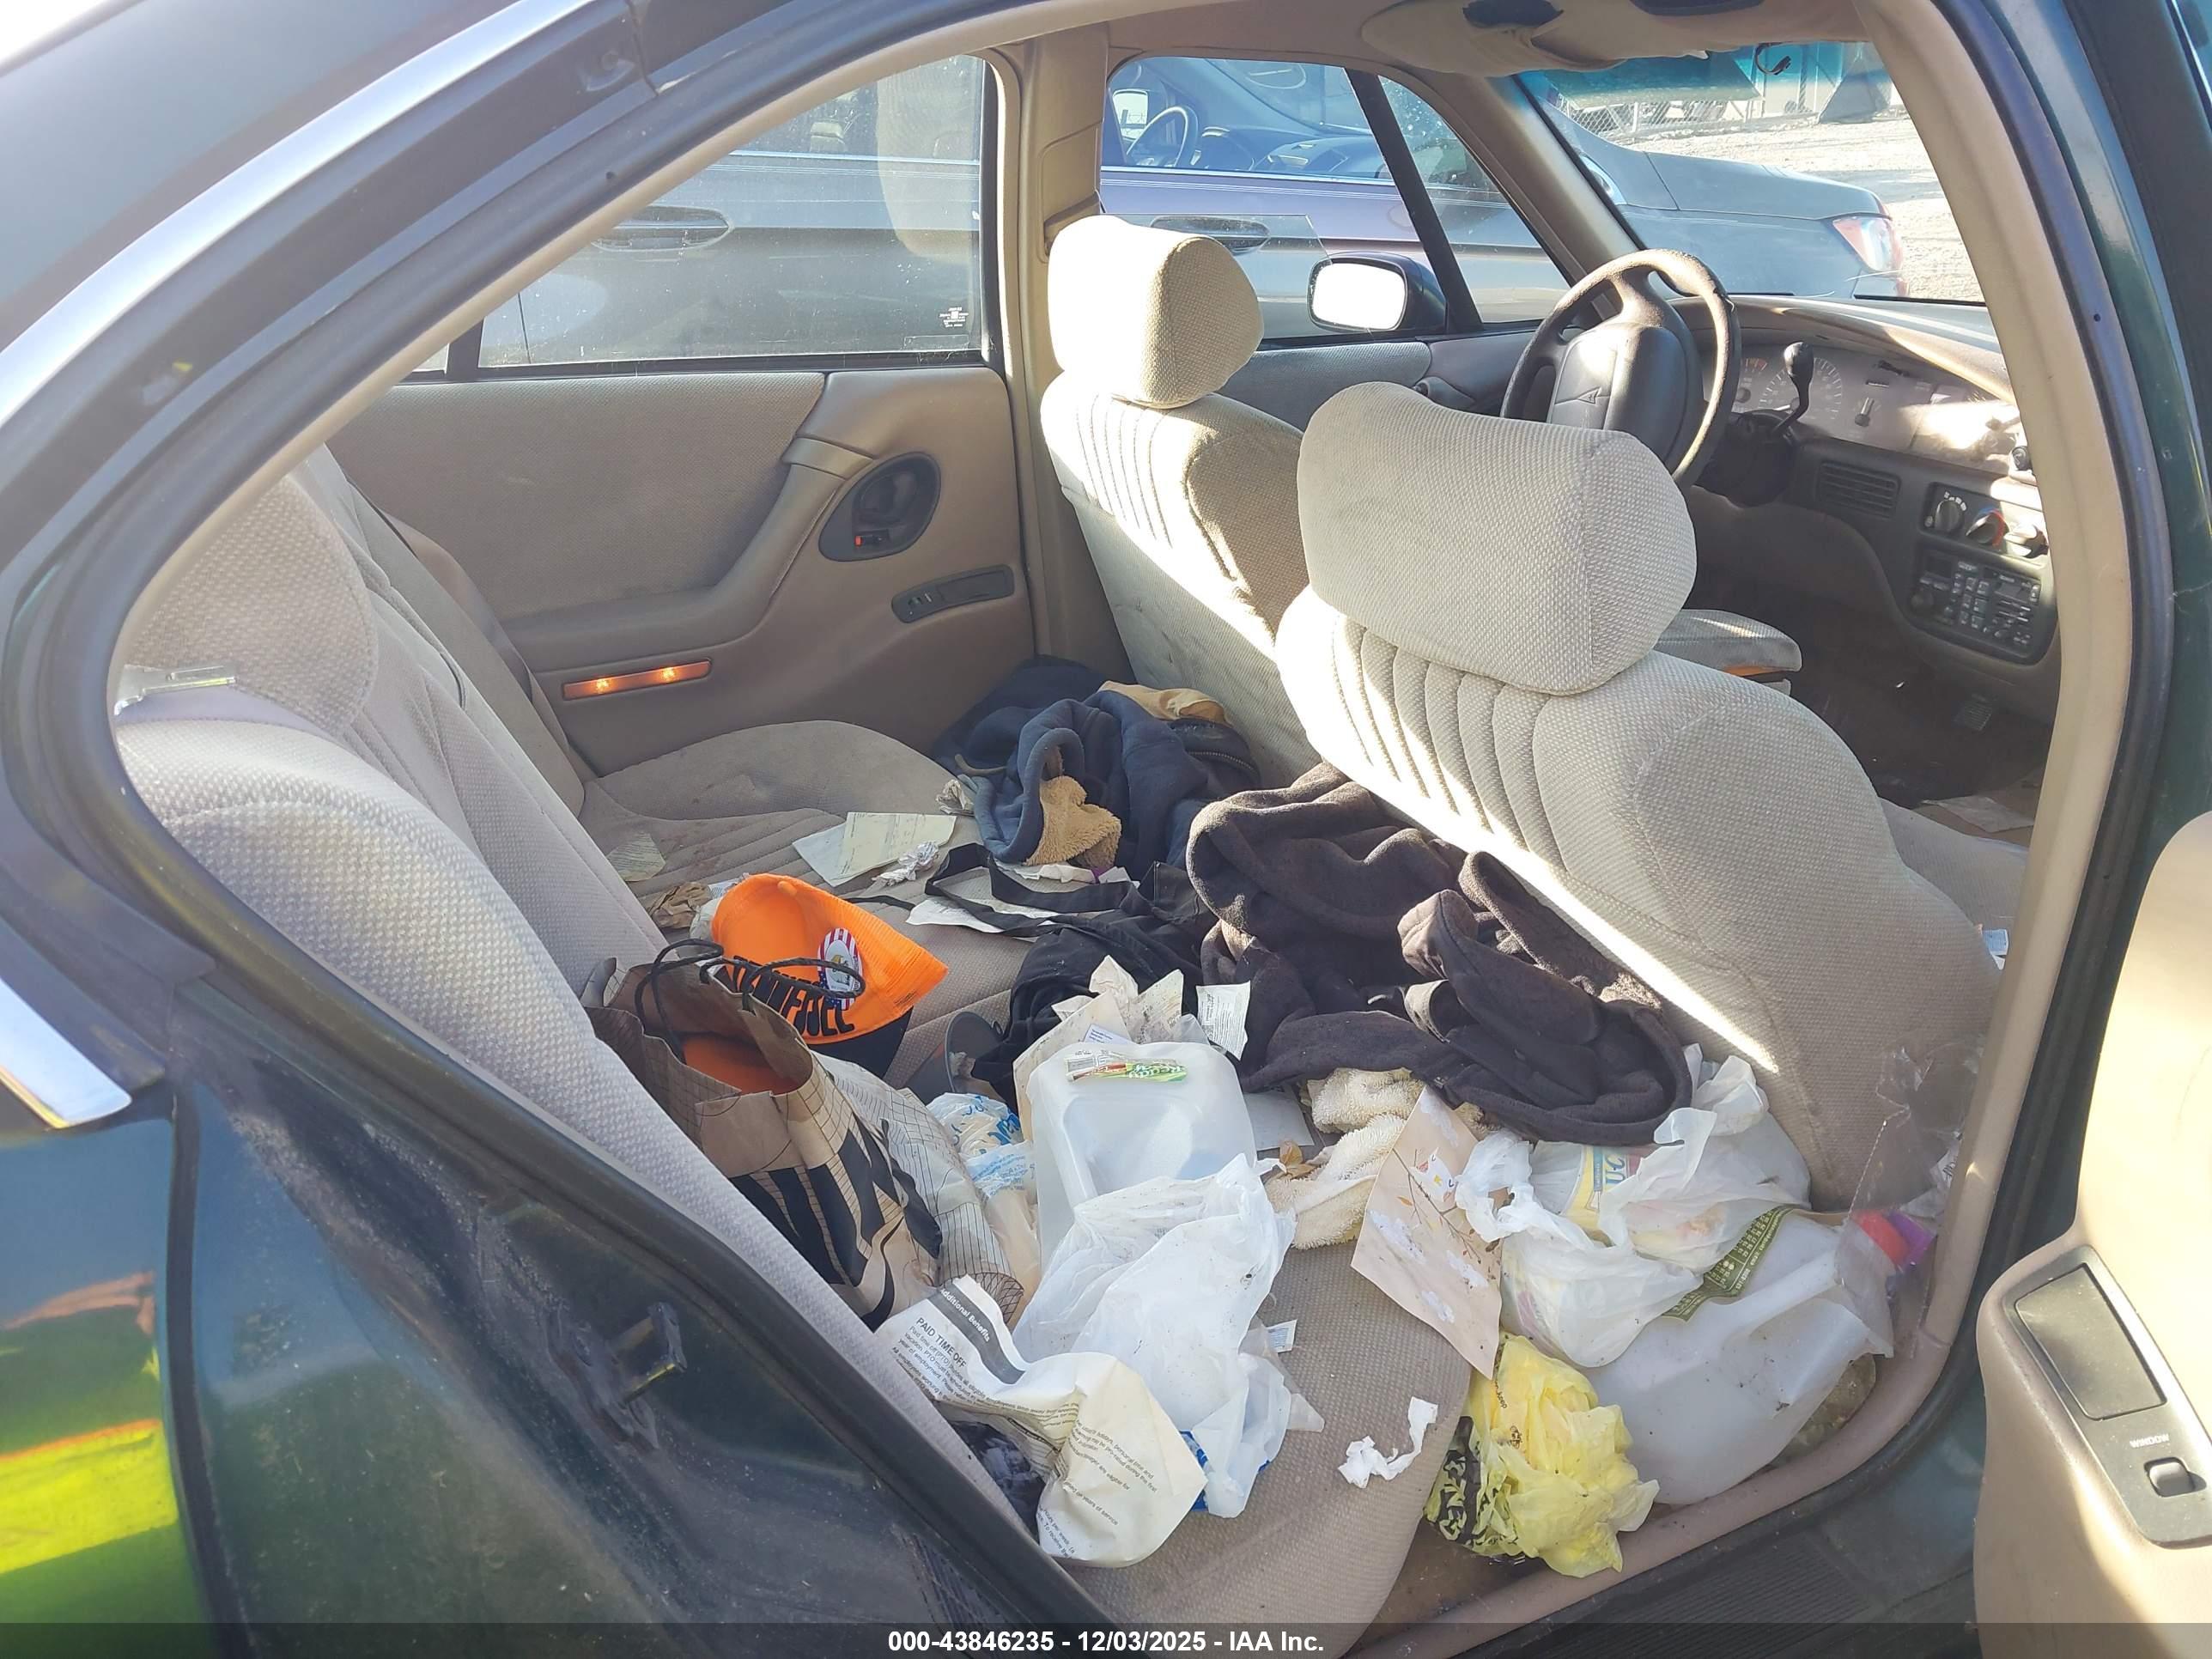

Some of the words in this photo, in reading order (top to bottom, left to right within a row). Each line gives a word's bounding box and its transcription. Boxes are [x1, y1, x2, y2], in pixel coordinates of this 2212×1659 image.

[940, 1288, 970, 1317] Additional
[969, 1315, 990, 1342] Benefits
[899, 1340, 909, 1350] year
[910, 1327, 921, 1338] Paid
[936, 1351, 951, 1366] (PTO)
[916, 1317, 936, 1338] PAID
[935, 1334, 955, 1356] TIME
[953, 1352, 967, 1368] OFF
[925, 1351, 935, 1362] PTO
[935, 1361, 946, 1372] must
[2129, 1432, 2170, 1449] WINDOW
[1114, 1444, 1135, 1463] personal
[1134, 1462, 1144, 1471] time
[1144, 1469, 1154, 1479] and
[1122, 1482, 1131, 1491] for
[1126, 1465, 1140, 1478] during
[1139, 1475, 1149, 1485] the
[1147, 1482, 1158, 1492] first
[1084, 1496, 1097, 1507] years
[1101, 1510, 1119, 1525] service
